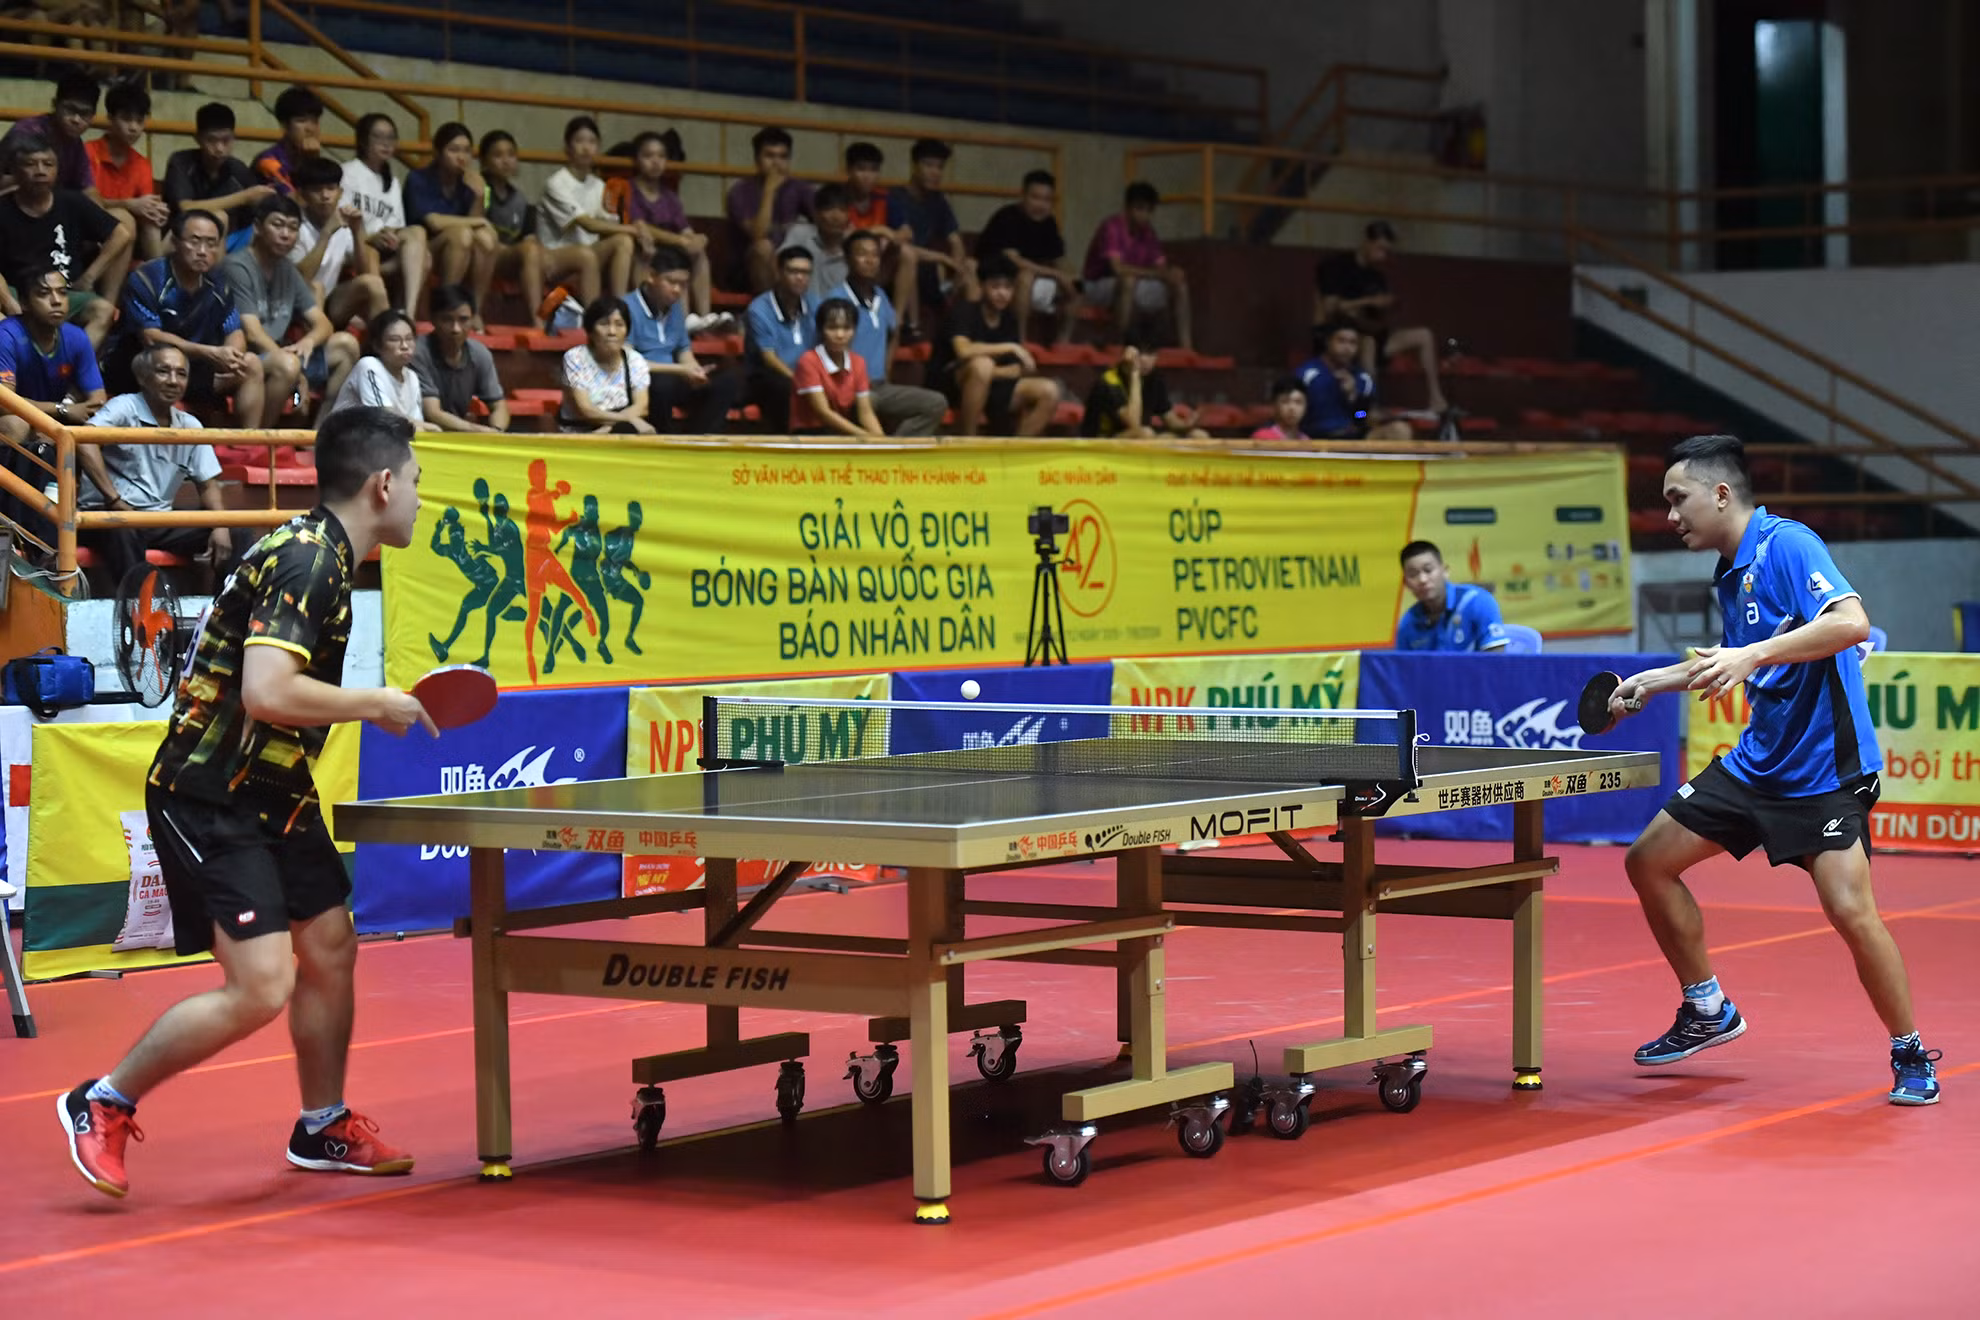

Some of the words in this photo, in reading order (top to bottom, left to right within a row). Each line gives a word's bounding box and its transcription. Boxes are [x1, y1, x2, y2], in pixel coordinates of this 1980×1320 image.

[800, 498, 861, 550] GIẢI
[870, 498, 910, 549] VÔ
[920, 511, 990, 555] ĐỊCH
[1168, 499, 1223, 545] CÚP
[691, 556, 778, 608] BÓNG
[788, 556, 849, 605] BÀN
[857, 546, 939, 603] QUỐC
[947, 565, 994, 601] GIA
[1173, 555, 1361, 593] PETROVIETNAM
[779, 609, 840, 660] BÁO
[849, 607, 930, 657] NHÂN
[940, 604, 996, 653] DÂN
[1177, 605, 1259, 641] PVCFC
[1131, 686, 1196, 734] NPK
[1207, 671, 1279, 731] PHÚ
[1291, 670, 1344, 727] MỸ
[650, 719, 704, 773] NP
[731, 705, 808, 764] PHÚ
[1564, 773, 1587, 794] 双鱼
[1599, 771, 1622, 790] 235
[1887, 748, 1941, 784] bội
[1438, 780, 1525, 810] 世乒赛器材供应商
[586, 828, 625, 852] 双鱼
[639, 831, 698, 850] 中国乒乓
[1122, 832, 1151, 847] Double
[1152, 829, 1171, 843] FISH
[1190, 804, 1303, 841] MOFIT
[1872, 812, 1919, 839] TIN
[1037, 830, 1078, 852] 中国乒乓
[725, 966, 790, 991] FISH
